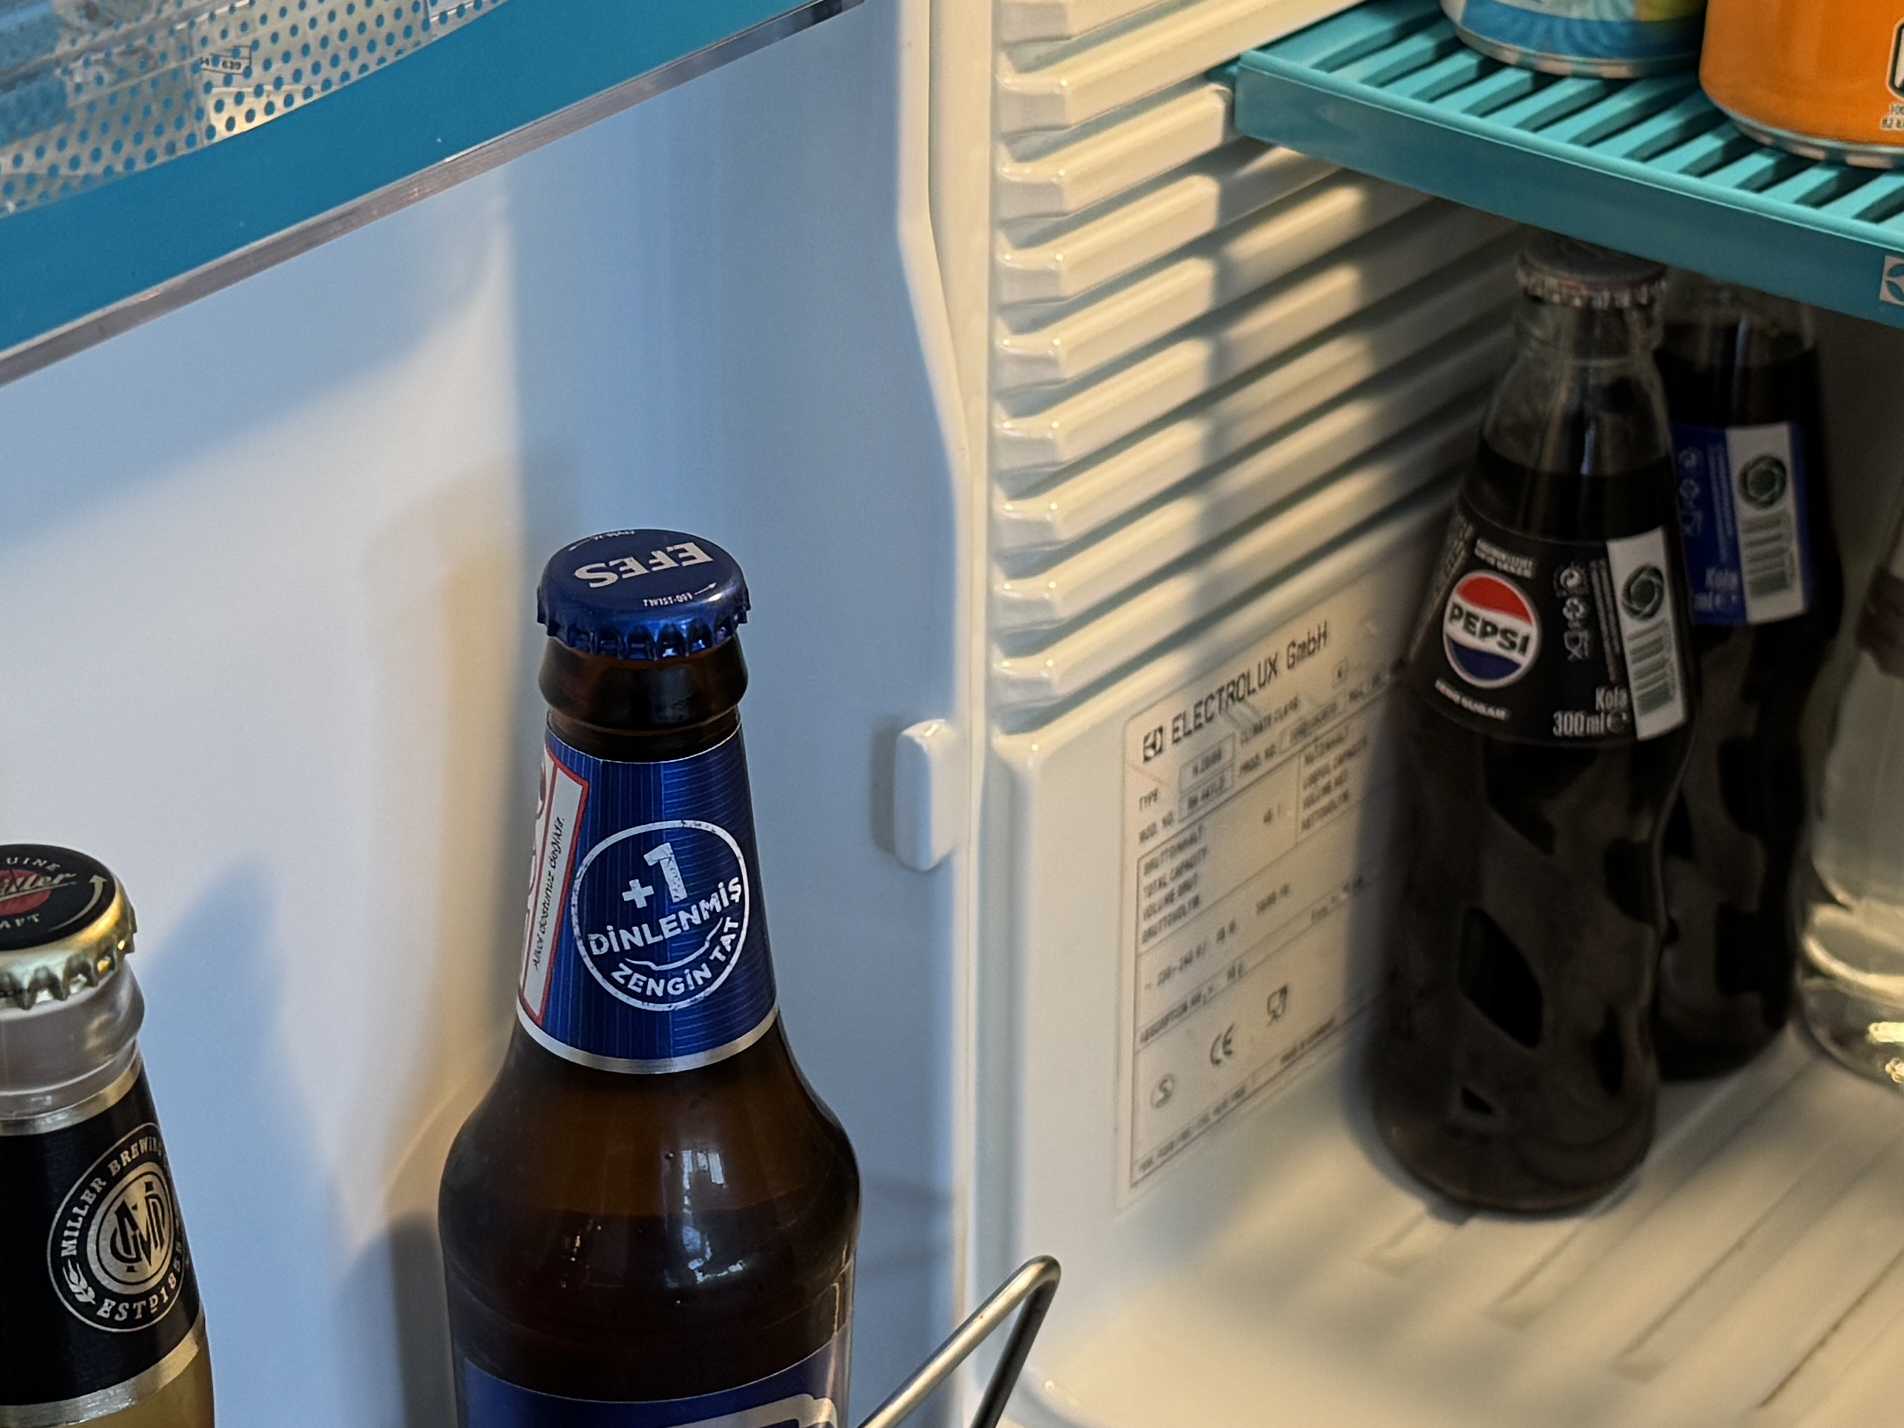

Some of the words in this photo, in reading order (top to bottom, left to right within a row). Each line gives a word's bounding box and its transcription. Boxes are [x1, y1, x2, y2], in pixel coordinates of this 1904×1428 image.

[574, 542, 714, 588] EFES
[1448, 602, 1531, 657] PEPSI
[1171, 651, 1279, 745] ELECTROLUX
[1286, 620, 1328, 671] GmbH
[1595, 685, 1629, 712] Kola
[622, 842, 688, 909] +1
[586, 876, 743, 956] DİNLENMİŞ
[611, 963, 713, 998] ZENGİN
[710, 915, 741, 966] TAT
[60, 1176, 108, 1258] MILLER
